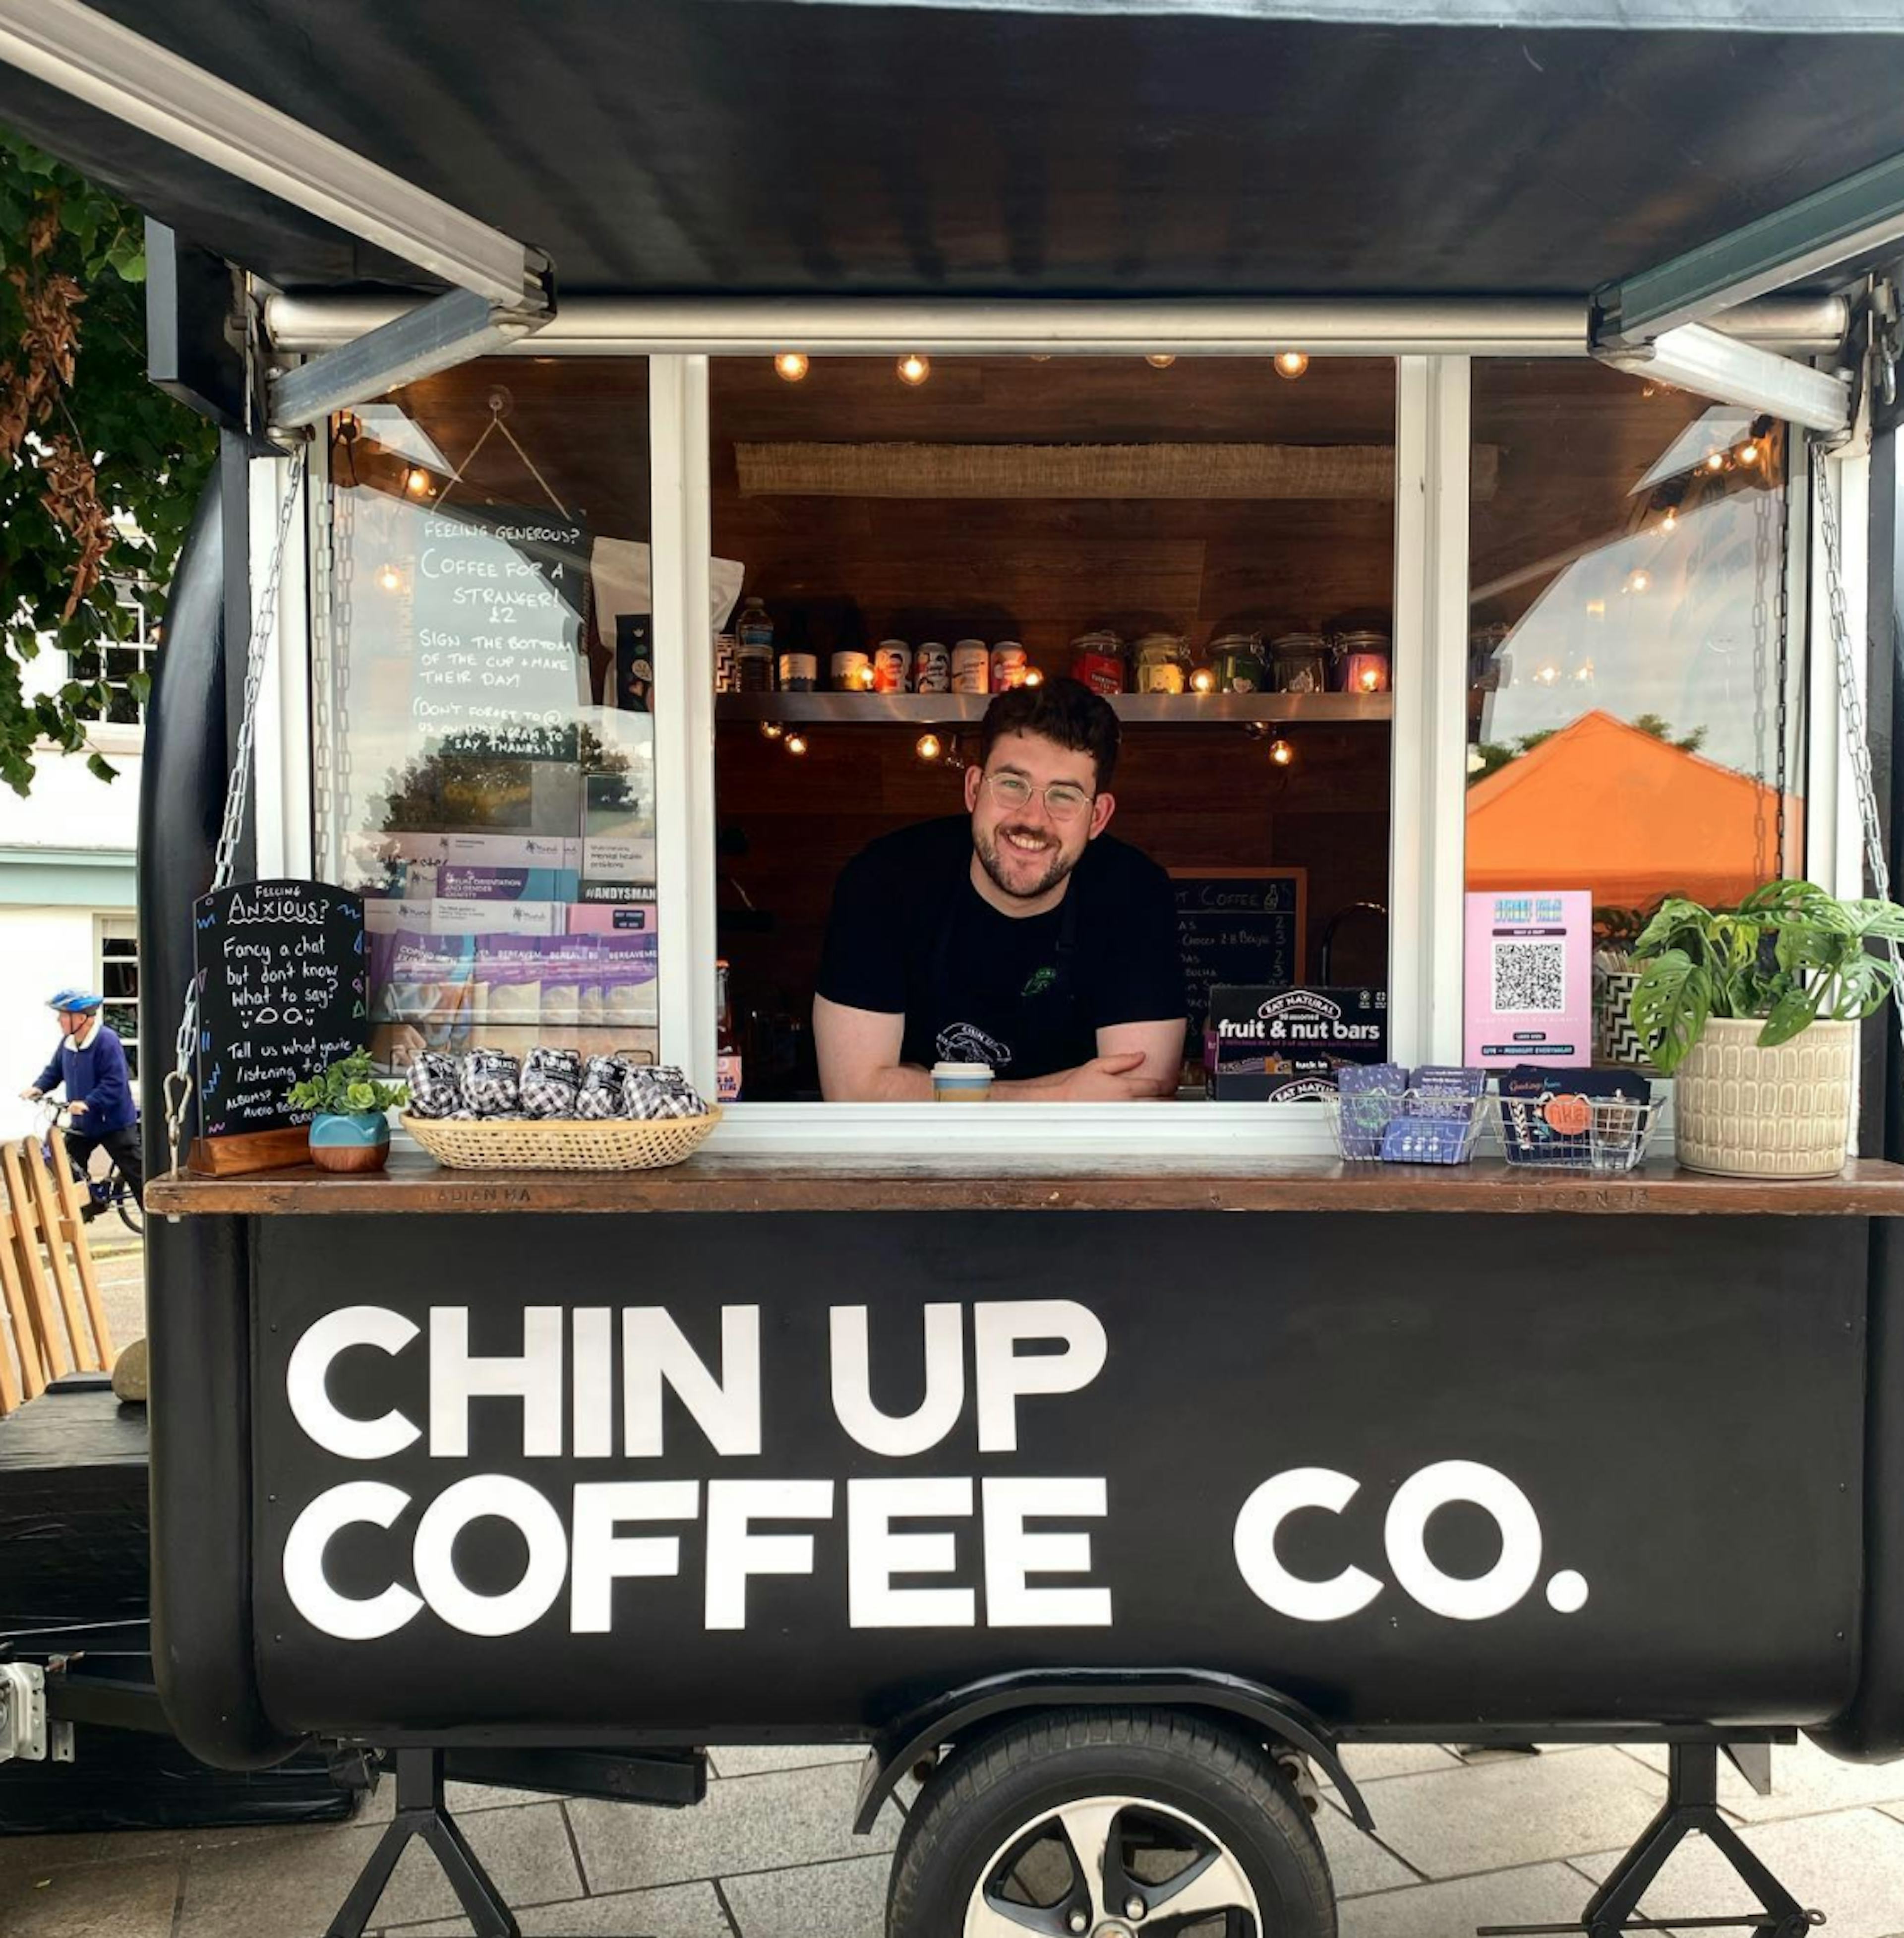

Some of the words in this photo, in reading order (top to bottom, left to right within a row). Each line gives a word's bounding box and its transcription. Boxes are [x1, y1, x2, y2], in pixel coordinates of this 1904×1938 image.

[425, 521, 488, 538] FEELING
[496, 525, 580, 544] GENEROUS?
[421, 548, 498, 578] COFFEE
[505, 562, 542, 578] FOR
[551, 563, 564, 579] A
[453, 588, 560, 608] STRANGER!
[488, 607, 517, 623] £2
[419, 629, 460, 647] SIGN
[471, 636, 503, 650] THE
[508, 636, 573, 653] BOTTOM
[421, 653, 440, 666] OF
[447, 653, 477, 666] THE
[486, 656, 514, 667] CUP
[532, 658, 569, 671] MAKE
[419, 670, 471, 684] THEIR
[522, 711, 540, 722] TO
[418, 722, 434, 732] US
[547, 731, 563, 742] TO
[454, 738, 480, 750] SAY
[224, 937, 272, 965] Fancy
[280, 945, 290, 957] a
[295, 934, 326, 956] chat
[226, 965, 249, 985] but
[260, 962, 296, 984] don't
[302, 960, 339, 979] know
[232, 988, 271, 1007] what
[281, 986, 298, 1002] to
[304, 978, 338, 1009] say?
[1265, 1001, 1286, 1014] EAT
[1287, 994, 1334, 1014] NATURAL
[1218, 1019, 1265, 1038] fruit
[1270, 1020, 1287, 1039] &
[1291, 1021, 1329, 1039] nut
[1332, 1020, 1380, 1040] bars
[227, 1042, 252, 1060] Tell
[261, 1044, 278, 1057] us
[282, 1037, 316, 1056] what
[237, 1065, 297, 1084] listening
[286, 1304, 762, 1459] CHIN
[830, 1299, 1108, 1456] UP
[282, 1474, 1113, 1640] COFFEE
[1234, 1459, 1589, 1621] CO.
